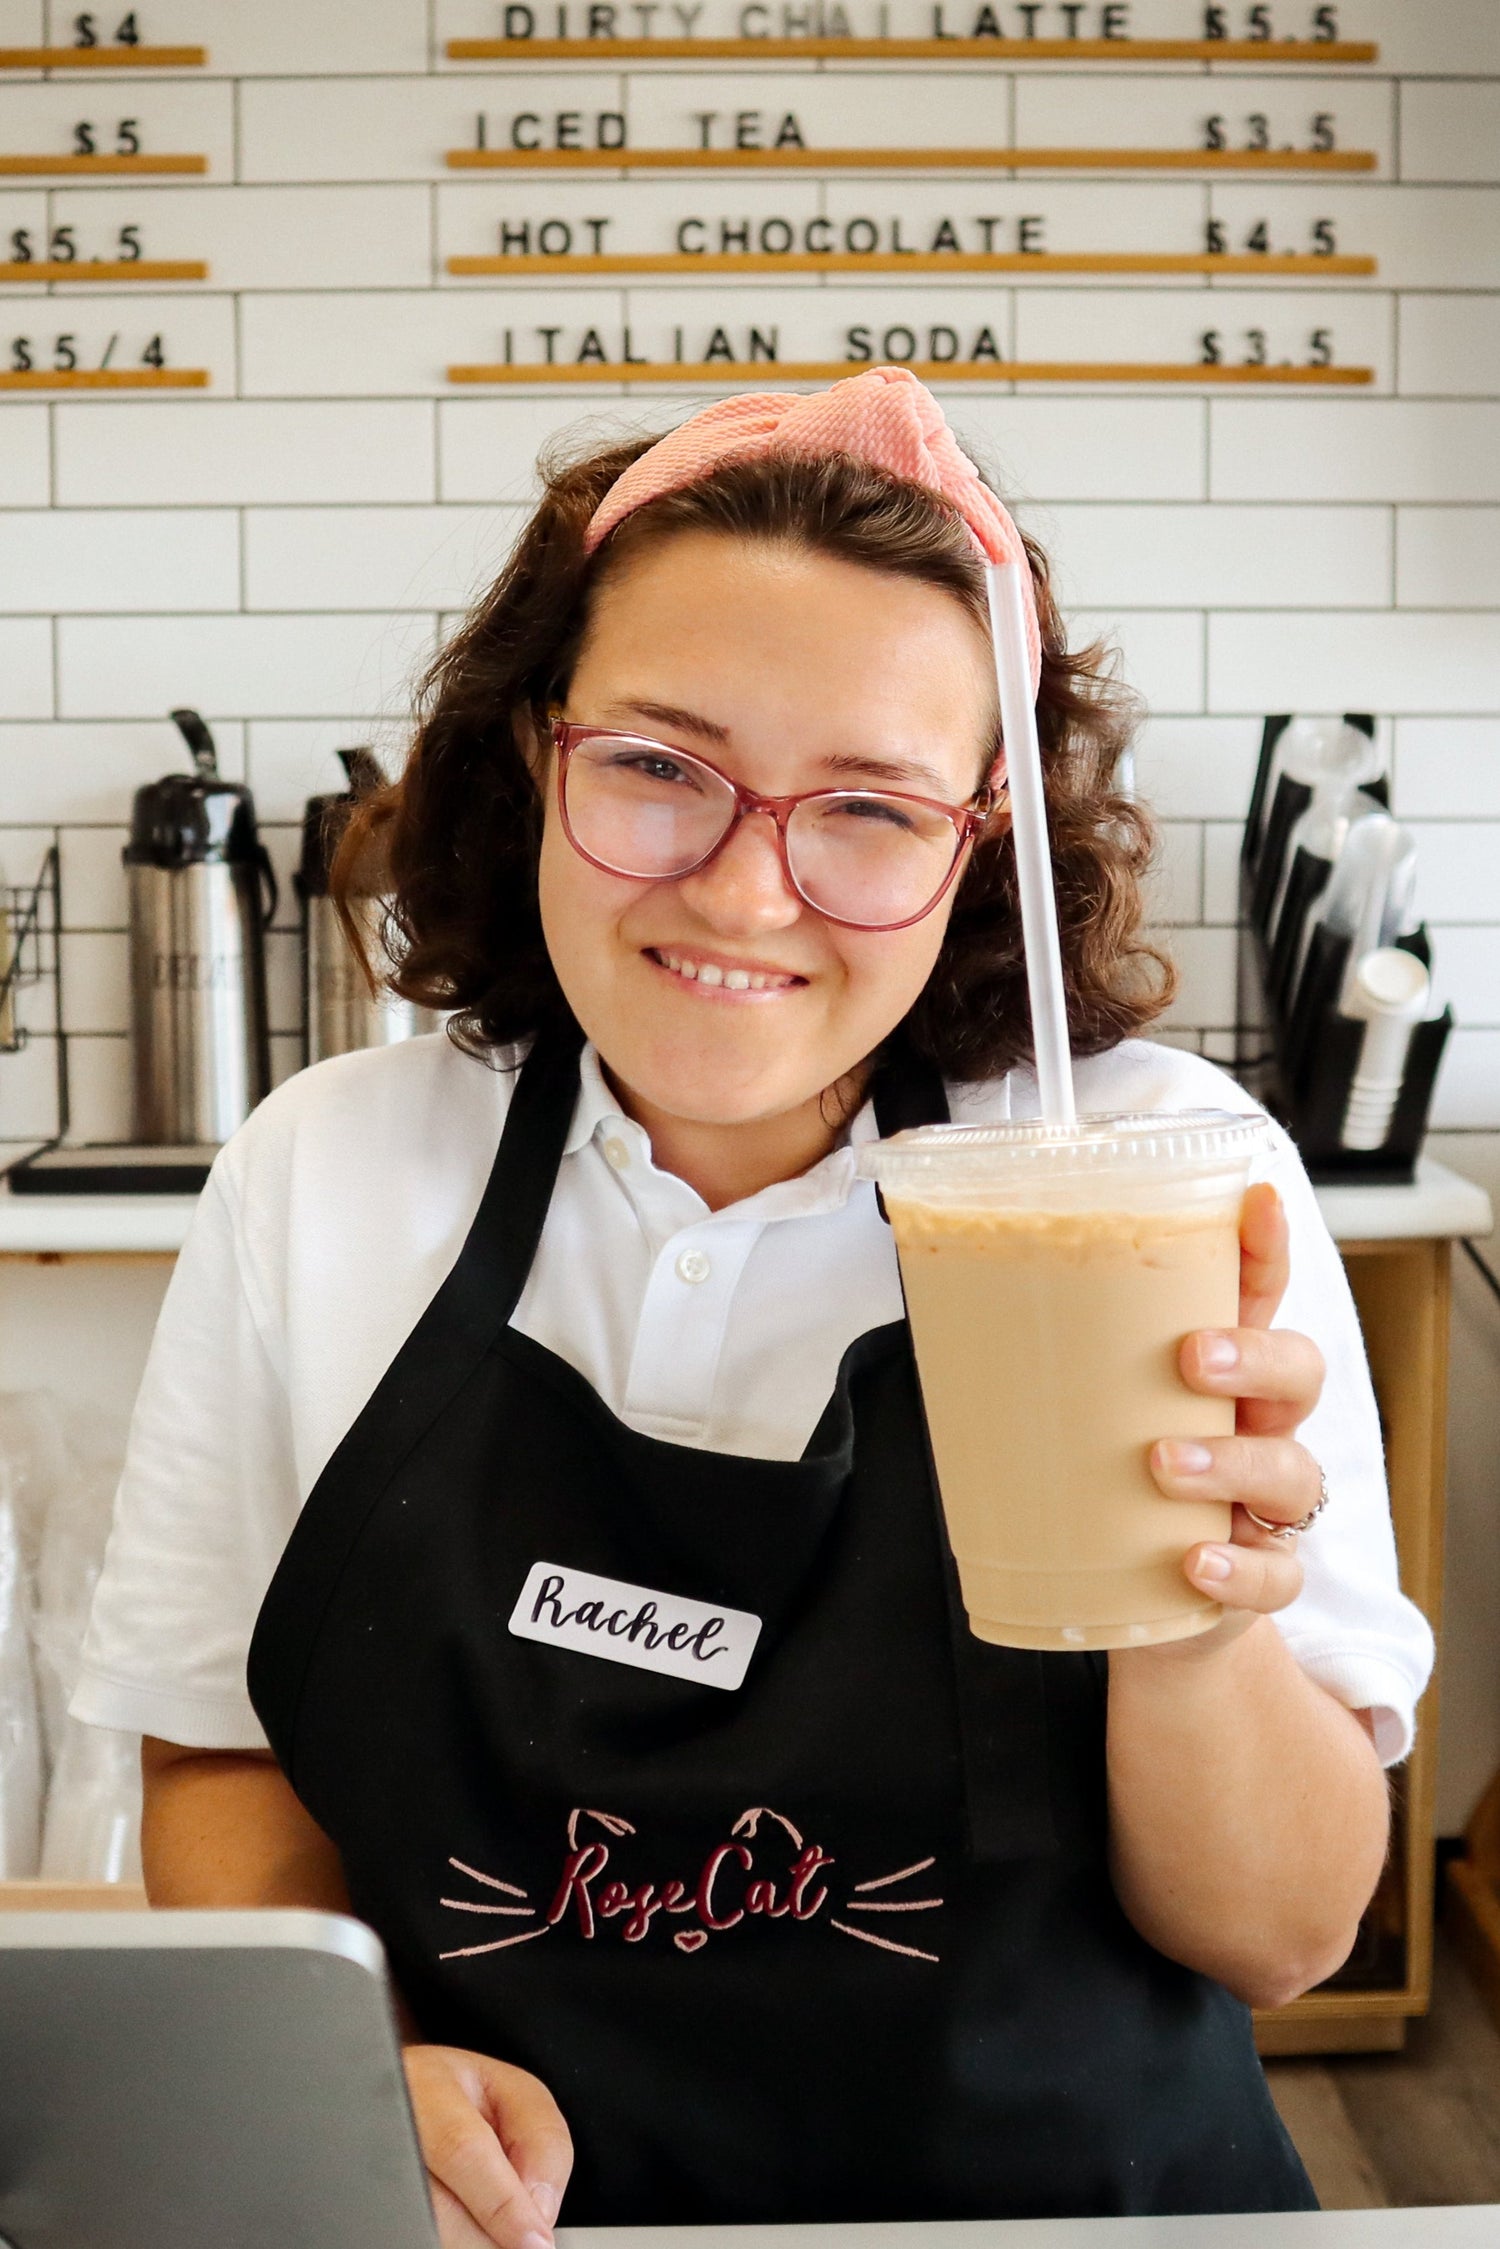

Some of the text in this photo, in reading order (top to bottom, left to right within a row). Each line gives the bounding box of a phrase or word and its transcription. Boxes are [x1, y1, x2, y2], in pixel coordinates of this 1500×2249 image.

[75, 12, 140, 47] $4
[502, 3, 1337, 42] DIRTY CHAI LATTE $5.5
[74, 119, 140, 154] $5
[477, 112, 1335, 151] ICED TEA $3.5
[11, 226, 141, 262] $5.5
[501, 217, 1335, 255] HOT CHOCOLATE $4.5
[12, 334, 165, 370] $5/4
[506, 327, 1331, 366] ITALIAN SODA $3.5
[530, 1575, 728, 1661] Rachel
